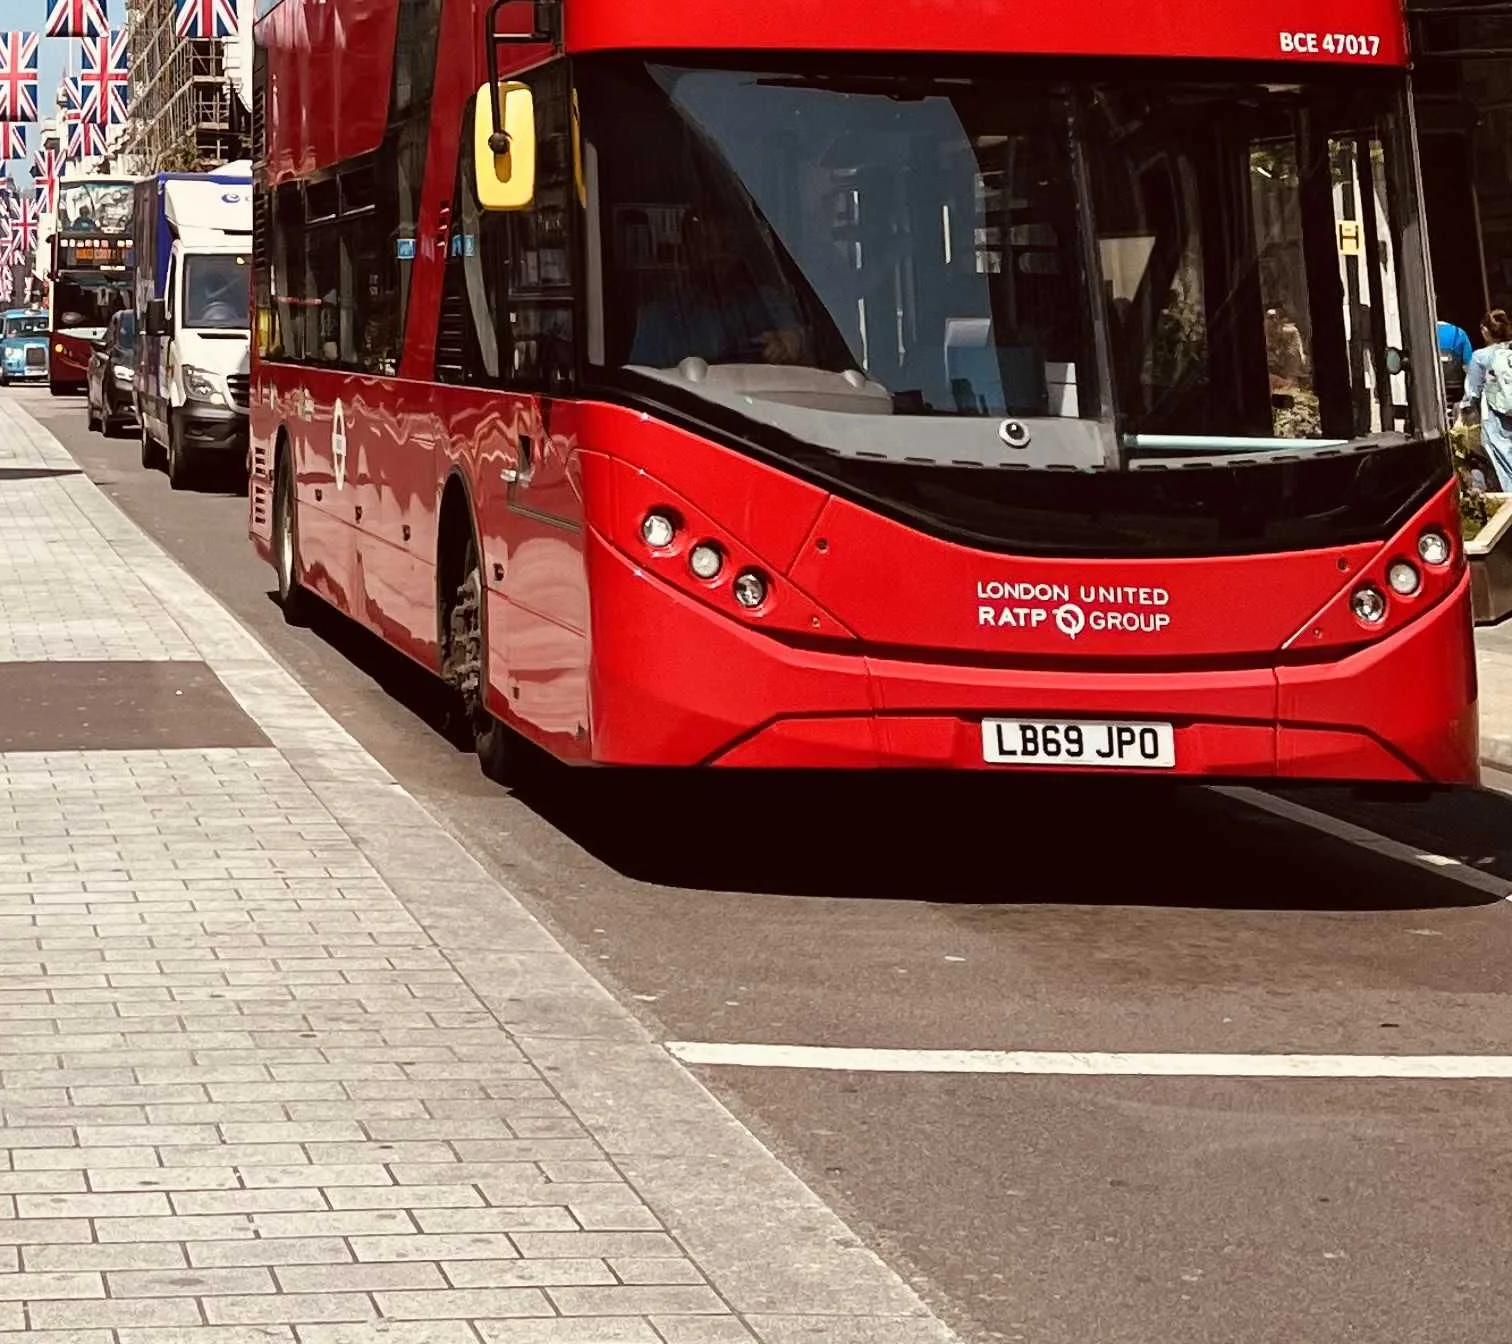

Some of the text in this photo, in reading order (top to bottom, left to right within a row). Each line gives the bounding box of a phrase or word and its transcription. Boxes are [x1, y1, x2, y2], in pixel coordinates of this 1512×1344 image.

[1279, 31, 1380, 56] BCE 47017
[977, 581, 1169, 605] LONDON UNITED
[978, 606, 1171, 632] RATP GROUP
[996, 723, 1160, 760] LB69 JPO
